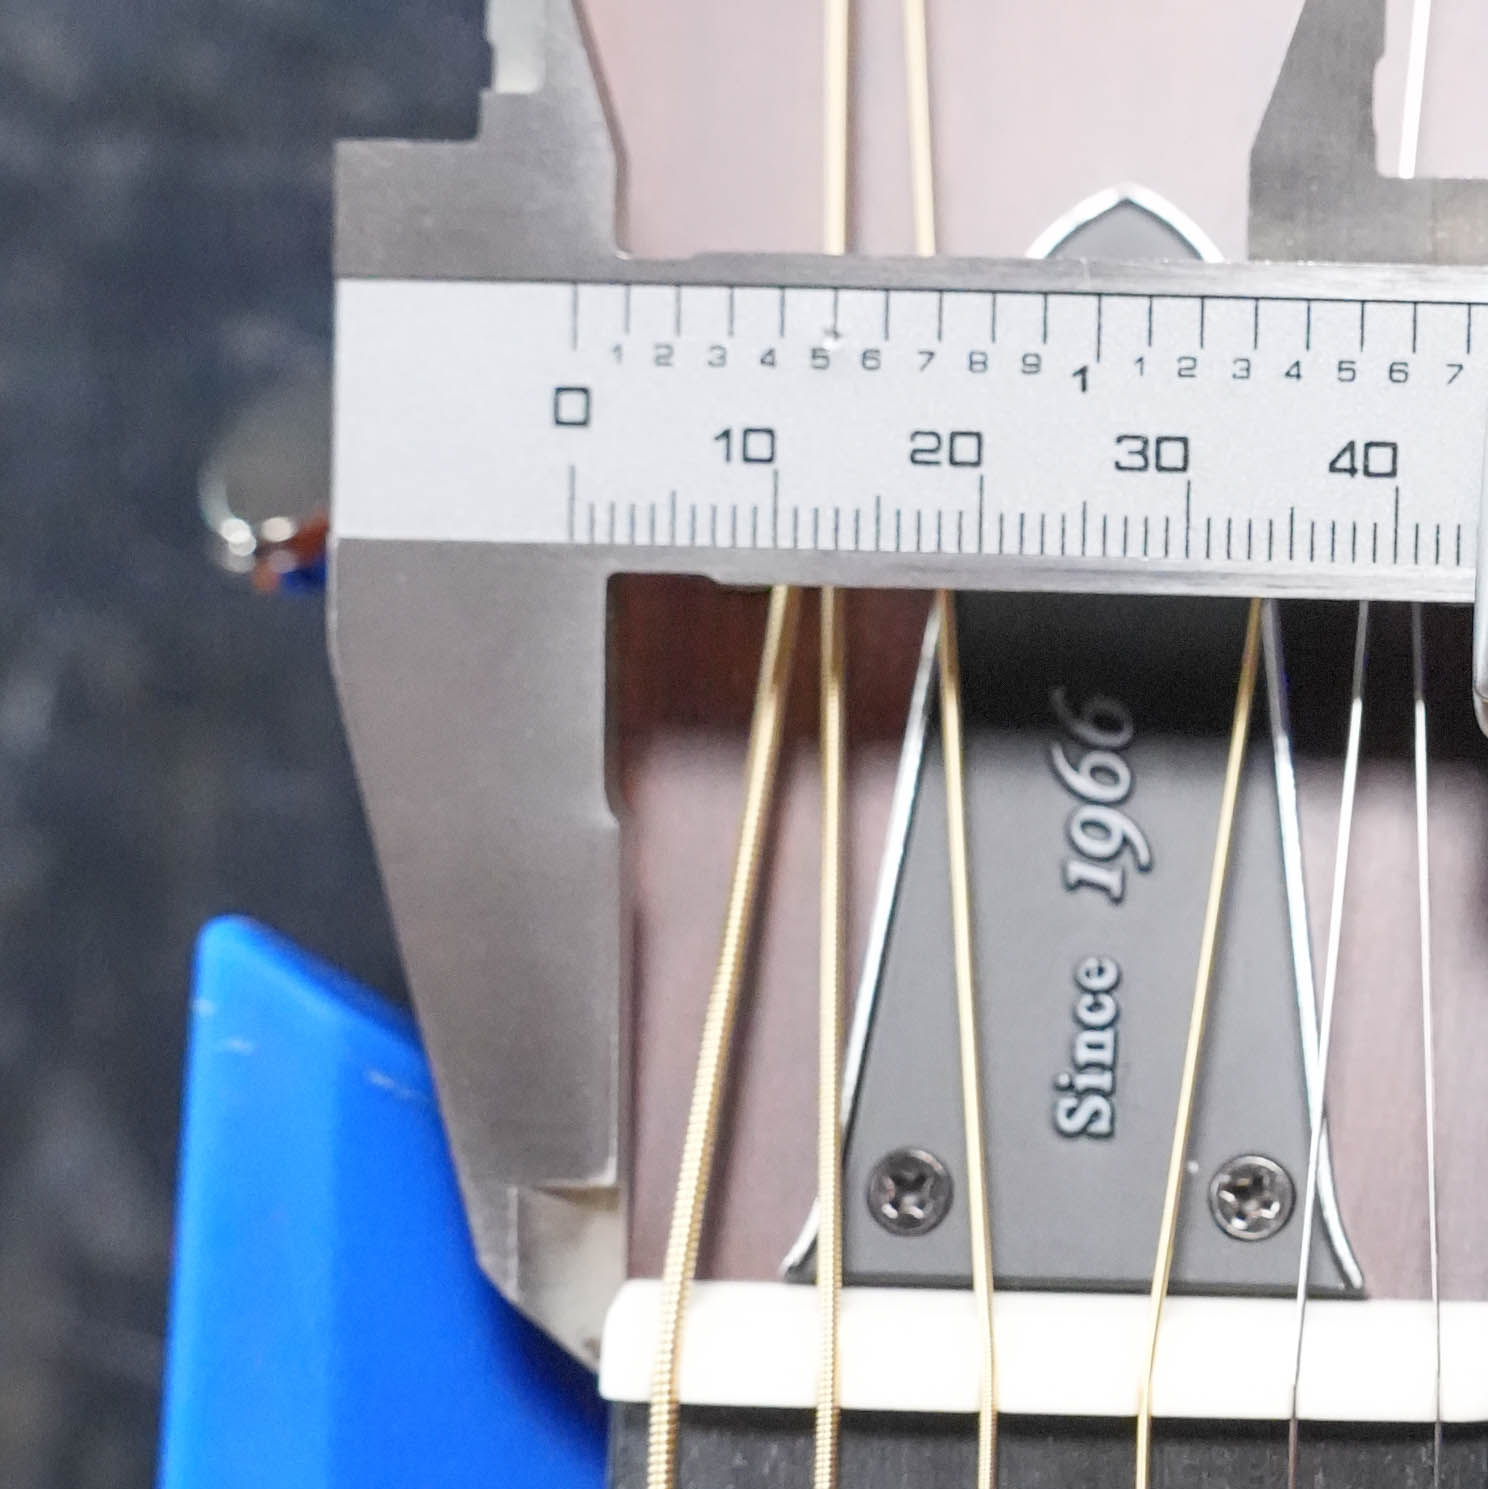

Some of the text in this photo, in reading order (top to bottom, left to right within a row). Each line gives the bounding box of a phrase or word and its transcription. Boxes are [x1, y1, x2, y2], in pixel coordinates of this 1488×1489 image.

[609, 341, 1465, 395] 1 2 3 4 5 6 7 8 9 1 1 2 3 4 5 6 7
[712, 424, 778, 466] 10
[906, 427, 986, 471] 20
[1112, 432, 1192, 475] 30
[1326, 438, 1401, 480] 40
[1050, 685, 1153, 1140] Since 1966
